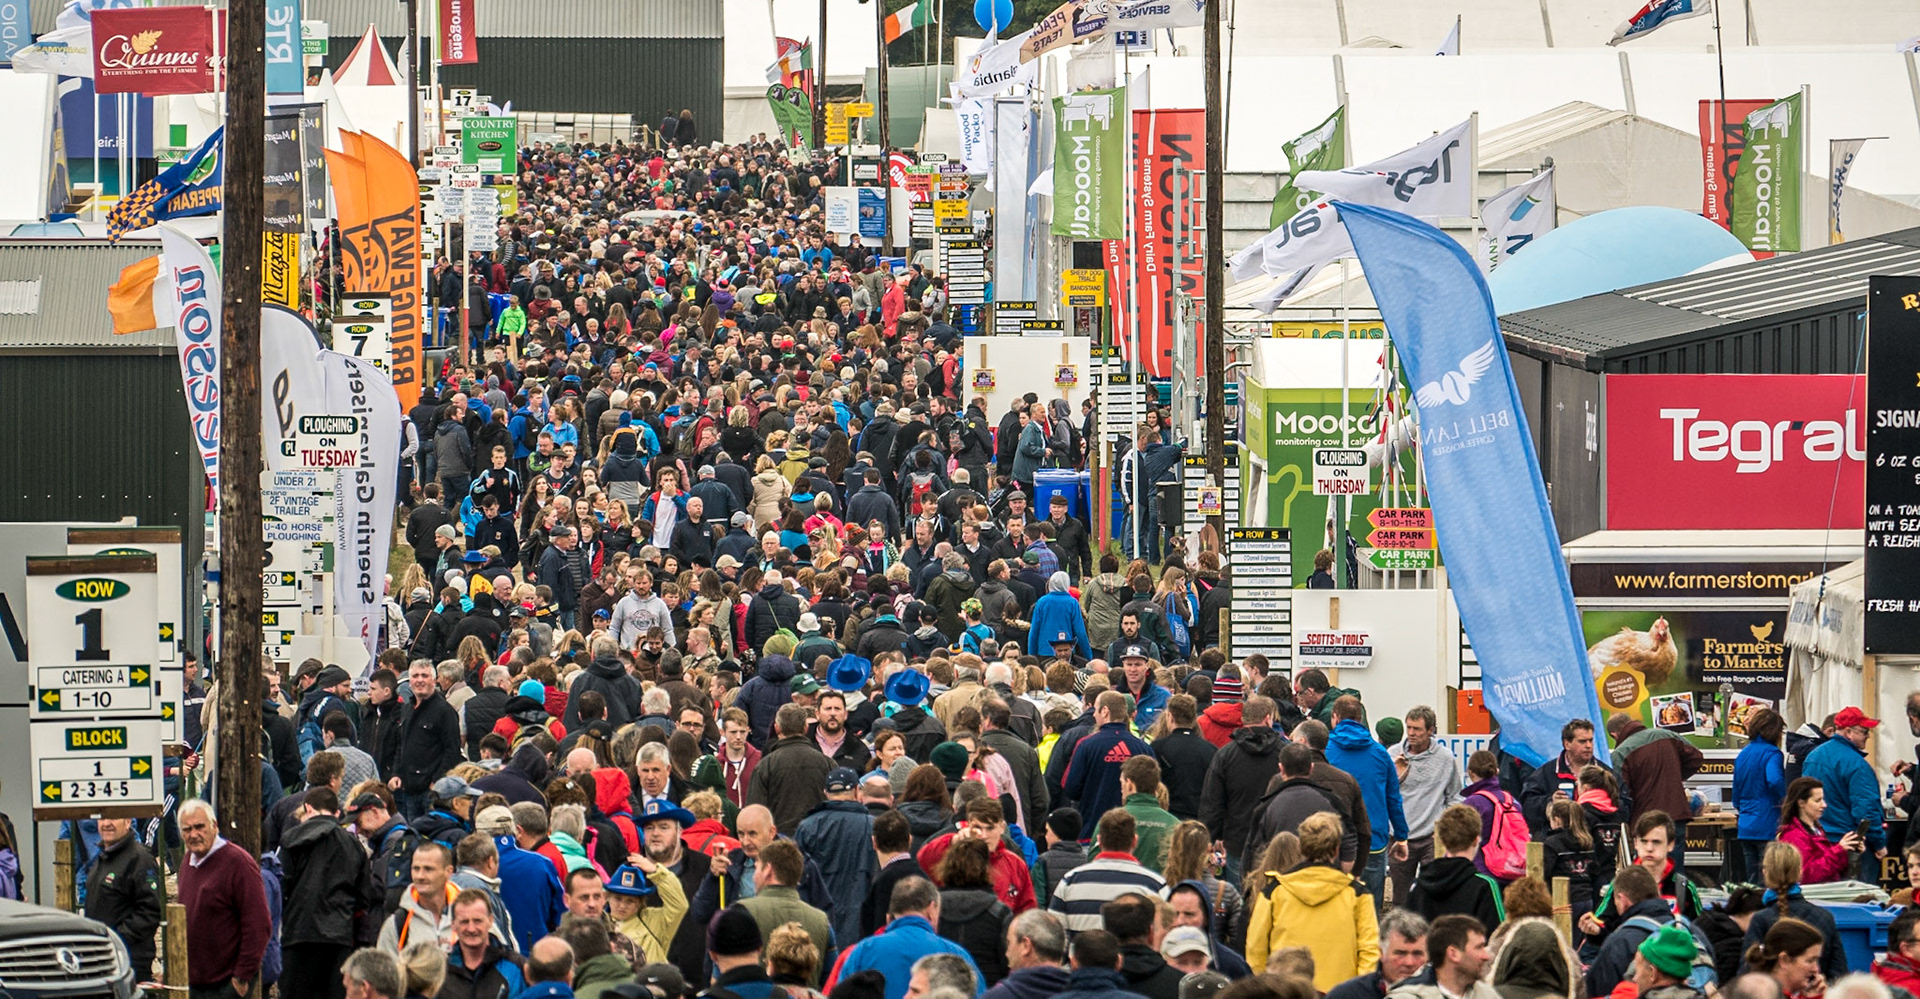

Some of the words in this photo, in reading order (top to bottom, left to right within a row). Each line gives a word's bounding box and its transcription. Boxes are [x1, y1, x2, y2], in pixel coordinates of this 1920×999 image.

[100, 35, 199, 69] Quinns
[455, 96, 471, 106] 17
[463, 119, 515, 129] COUNTRY
[972, 113, 981, 144] Packo
[470, 131, 509, 139] KITCHEN
[453, 180, 478, 188] TUESDAY
[1069, 269, 1087, 277] SHEEP
[1069, 284, 1102, 292] BANDSTAND
[359, 301, 375, 309] ROW
[351, 325, 368, 333] ROW
[350, 335, 368, 356] 7
[1108, 348, 1115, 356] 8
[303, 417, 353, 433] PLOUGHING
[319, 437, 337, 447] ON
[1275, 436, 1321, 448] monitoring
[1323, 438, 1340, 446] cow
[1350, 437, 1365, 446] calf
[1659, 408, 1866, 474] Tegral
[301, 450, 358, 467] TUESDAY
[1318, 451, 1363, 465] PLOUGHING
[1875, 453, 1886, 467] 6
[1890, 455, 1907, 467] OZ
[1333, 469, 1349, 477] ON
[273, 476, 304, 486] UNDER
[307, 477, 317, 486] 21
[1317, 479, 1366, 494] THURSDAY
[269, 496, 280, 505] 2F
[283, 496, 319, 506] VINTAGE
[274, 506, 310, 515] TRAILER
[1378, 510, 1397, 519] CAR
[1400, 510, 1426, 519] PARK
[1868, 504, 1880, 516] ON
[1884, 504, 1893, 516] A
[263, 523, 288, 531] U-40
[291, 523, 323, 531] HORSE
[1379, 519, 1426, 528] 8-10-11-12
[1868, 520, 1895, 532] WITH
[267, 532, 321, 541] PLOUGHING
[1245, 530, 1265, 539] ROW
[1271, 530, 1279, 539] 5
[1377, 530, 1396, 540] CAR
[1400, 531, 1425, 540] PARK
[1377, 540, 1416, 548] 7-8-9-10-12
[1868, 534, 1878, 548] A
[1379, 550, 1400, 560] CAR
[1403, 551, 1431, 560] PARK
[1385, 559, 1427, 568] 4-5-6-7-9
[75, 580, 116, 597] ROW
[1868, 600, 1904, 612] FRESH
[74, 608, 110, 662] 1
[1299, 633, 1336, 645] SCOTTS
[1341, 634, 1369, 645] TOOLS
[1702, 638, 1785, 655] Farmers
[1703, 655, 1722, 669] to
[1723, 655, 1784, 669] Market
[62, 668, 113, 685] CATERING
[117, 669, 125, 683] A
[1702, 675, 1716, 683] Irish
[1717, 675, 1732, 683] Free
[1733, 675, 1755, 684] Range
[1756, 675, 1785, 683] Chicken
[73, 691, 112, 708] 1-10
[71, 729, 123, 746] BLOCK
[93, 761, 104, 777] 1
[70, 780, 129, 798] 2-3-4-5
